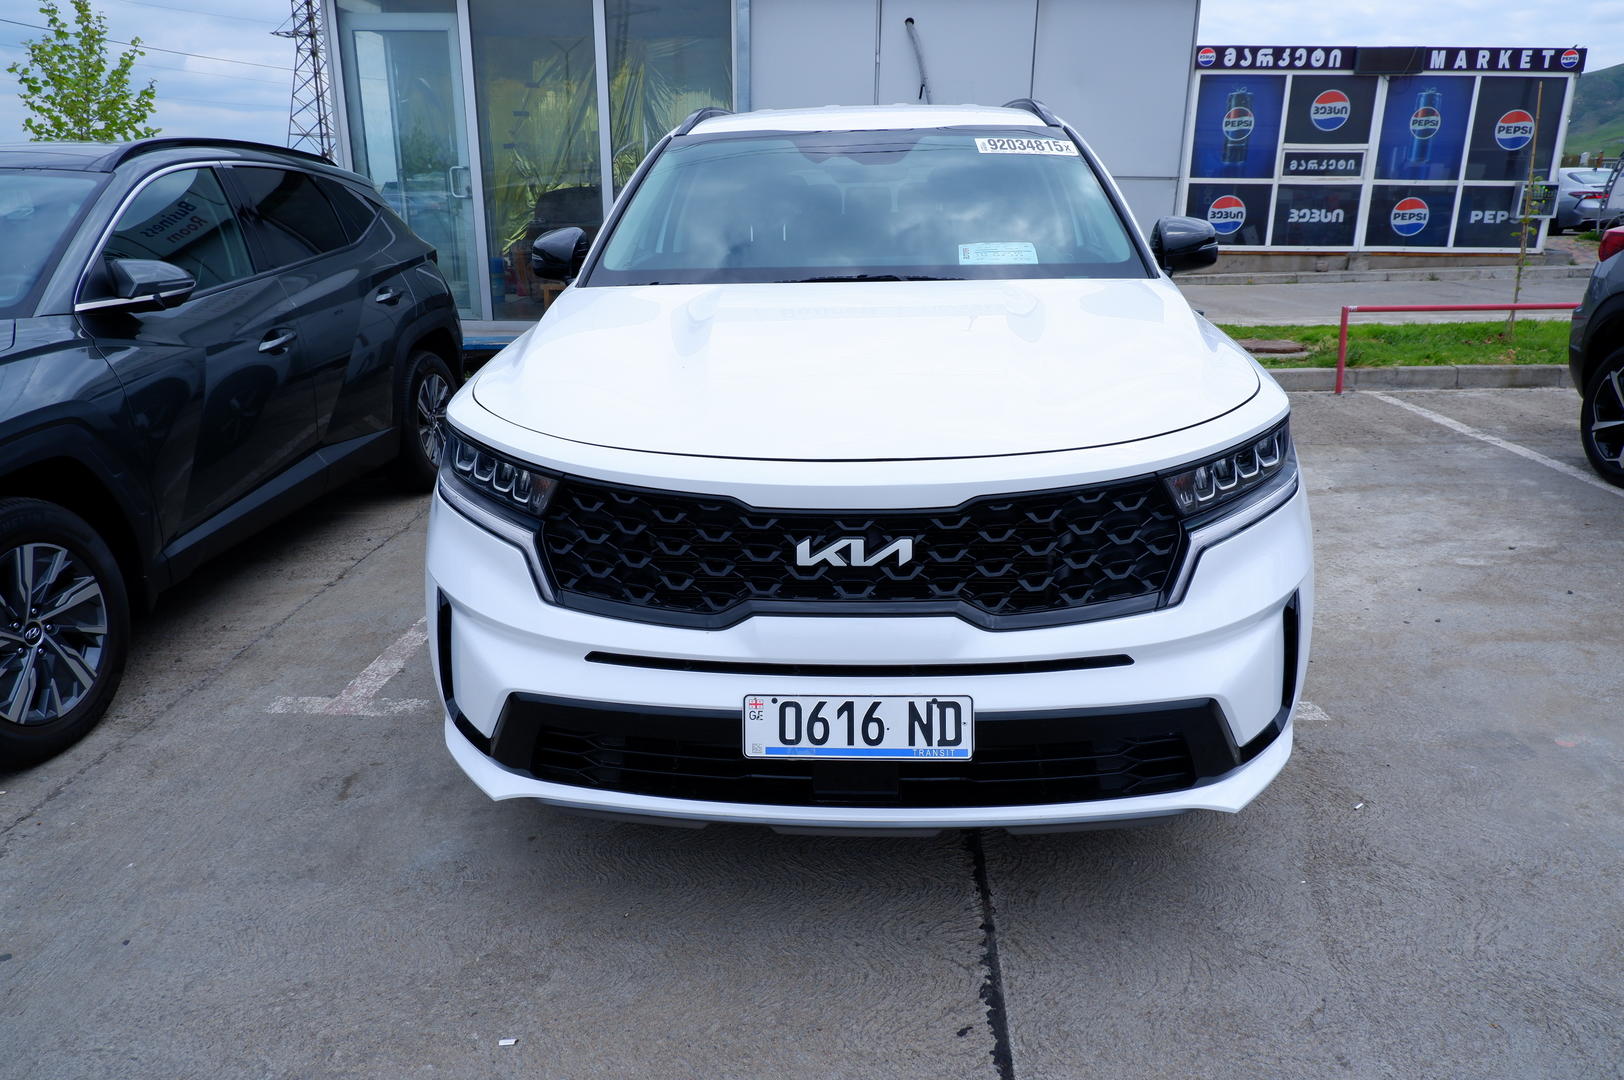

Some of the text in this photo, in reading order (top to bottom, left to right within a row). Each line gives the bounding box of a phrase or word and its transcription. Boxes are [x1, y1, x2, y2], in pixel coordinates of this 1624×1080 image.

[1223, 47, 1342, 68] მარკეტი
[1429, 49, 1555, 69] MARKET
[1225, 120, 1252, 128] PEPSI
[1411, 119, 1439, 128] PEPSI
[1497, 124, 1533, 135] PEPSI
[1289, 159, 1356, 171] მარკეტი
[1393, 212, 1427, 221] PEPSI
[1469, 210, 1521, 224] PEP
[796, 537, 913, 567] KIA
[749, 710, 764, 721] GE
[778, 700, 963, 747] 0616 ND
[912, 749, 956, 758] TRANSIT
